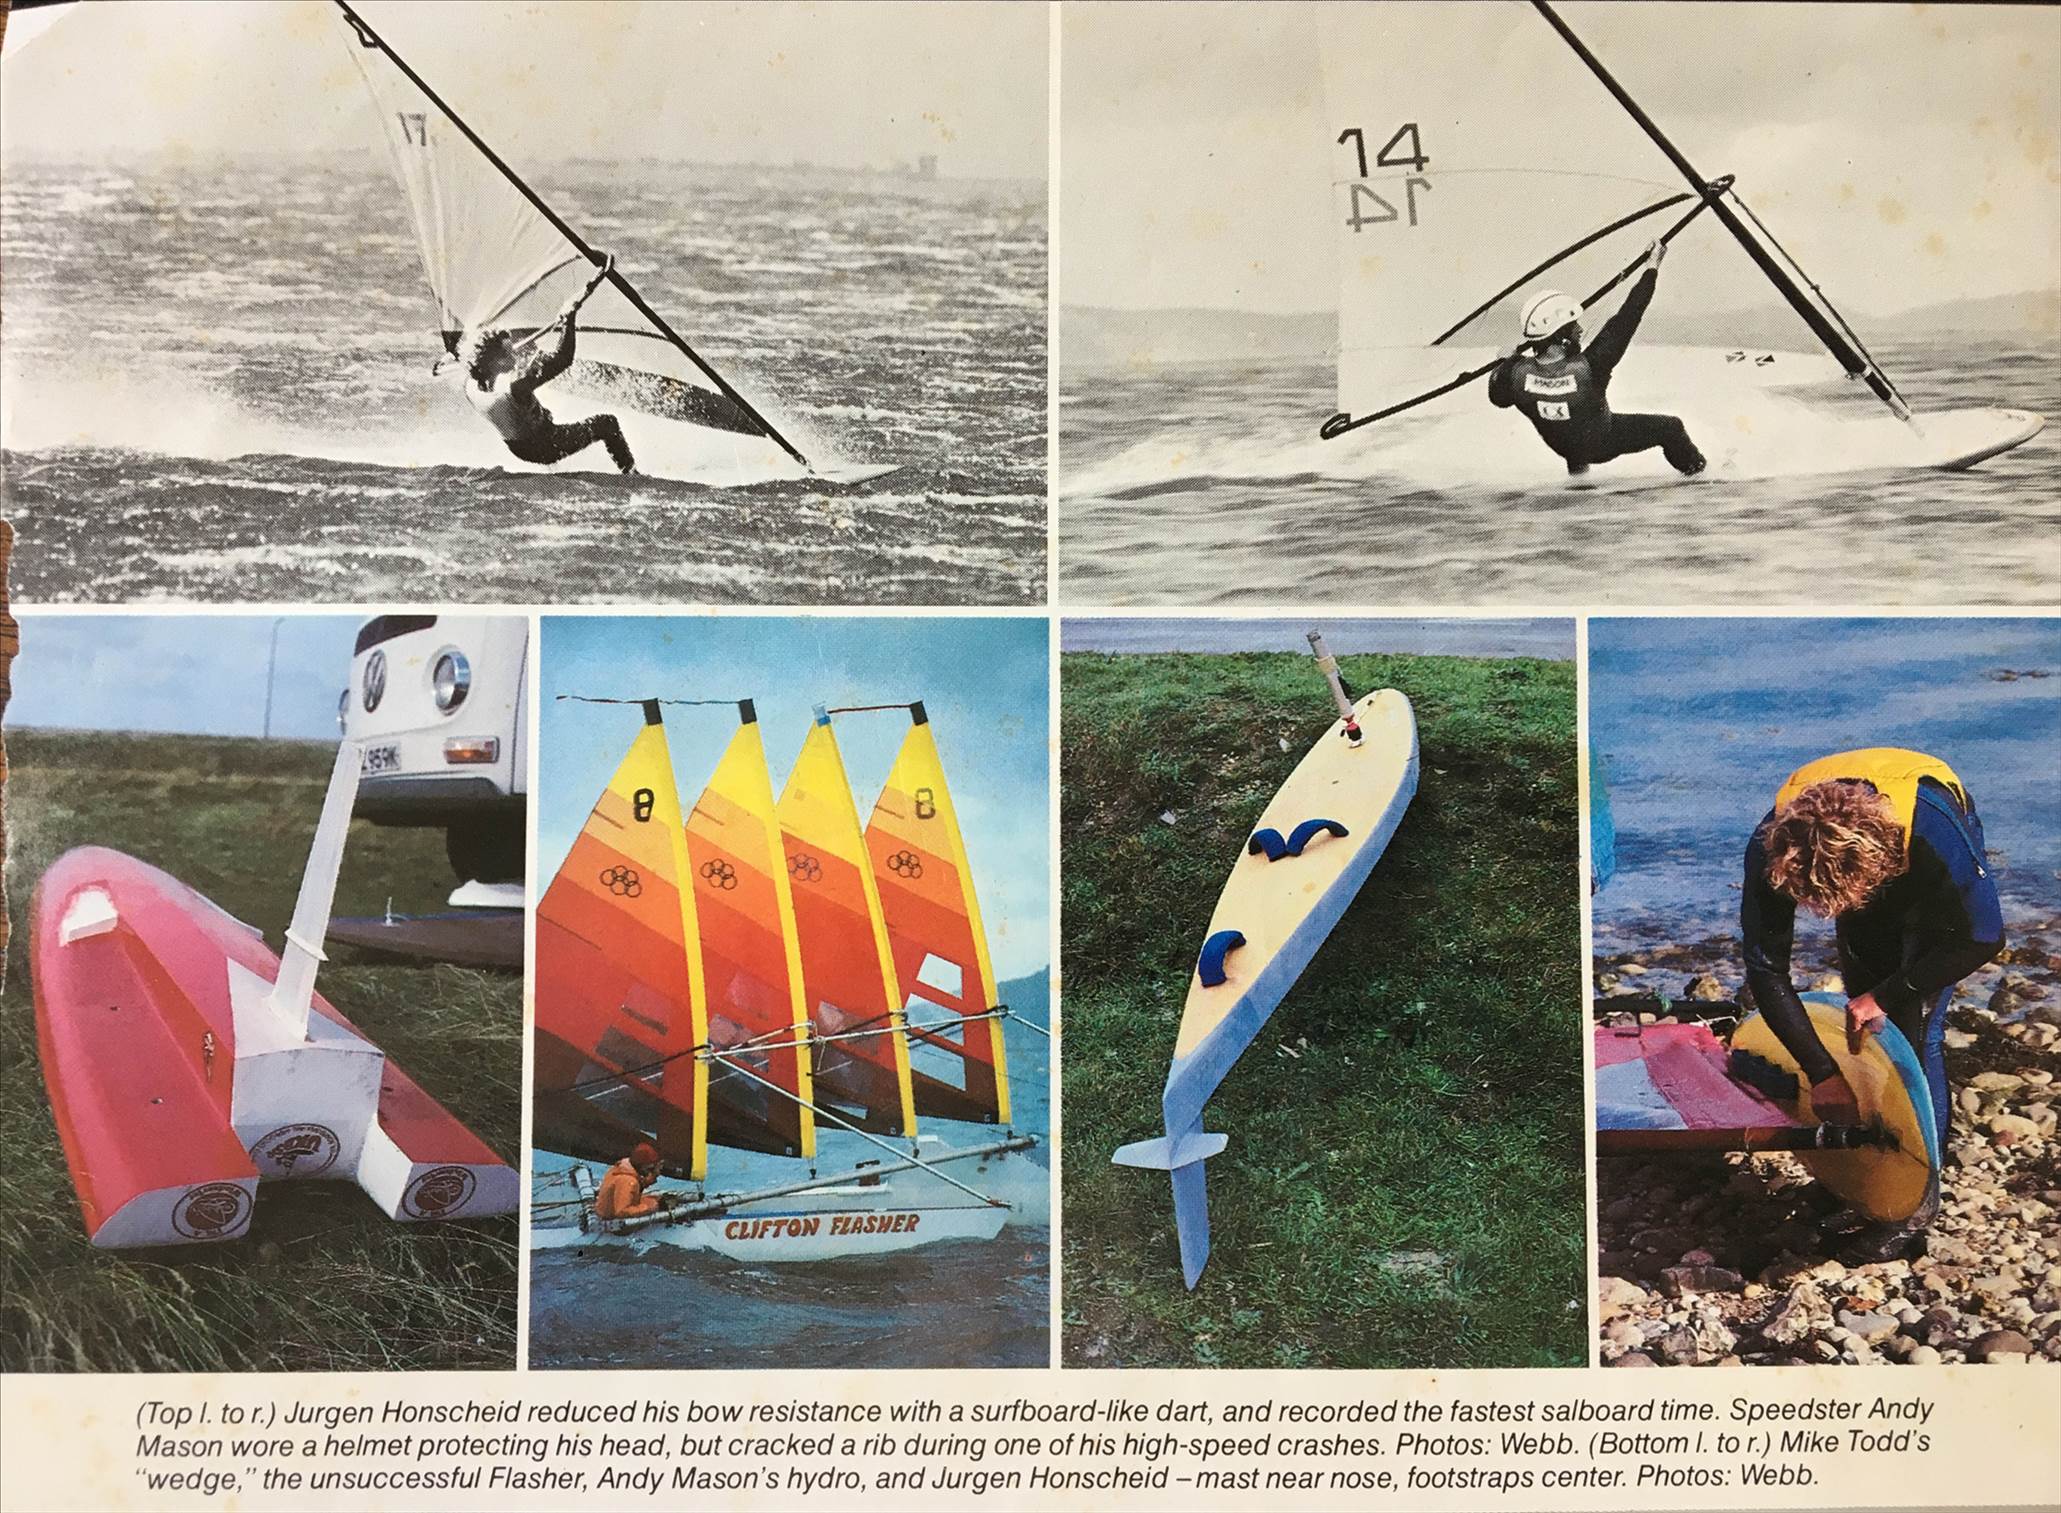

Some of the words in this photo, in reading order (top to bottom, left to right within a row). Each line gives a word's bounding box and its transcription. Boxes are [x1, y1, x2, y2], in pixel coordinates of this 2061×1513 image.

[1337, 122, 1430, 178] 14
[915, 787, 936, 820] 8
[725, 1217, 820, 1241] CLIFTON
[829, 1213, 921, 1236] FLASHER
[136, 1400, 193, 1431] (Top
[199, 1401, 212, 1424] l.
[221, 1402, 245, 1425] to
[250, 1401, 276, 1430] r.)
[283, 1400, 374, 1430] Jurgen
[381, 1399, 523, 1424] Honscheid
[527, 1399, 638, 1424] reduced
[642, 1399, 680, 1424] his
[686, 1399, 745, 1423] bow
[748, 1399, 882, 1423] resistance
[889, 1399, 942, 1423] with
[948, 1404, 964, 1423] a
[970, 1398, 1149, 1423] surfboard-like
[1155, 1398, 1213, 1426] dart,
[1222, 1399, 1273, 1423] and
[1278, 1399, 1399, 1424] recorded
[1403, 1399, 1444, 1423] the
[1450, 1399, 1536, 1423] fastest
[1540, 1398, 1656, 1423] salboard
[1660, 1398, 1720, 1421] time.
[1729, 1397, 1863, 1427] Speedster
[1867, 1396, 1935, 1426] Andy
[135, 1434, 223, 1458] Mason
[231, 1439, 295, 1458] wore
[301, 1439, 318, 1458] a
[323, 1433, 413, 1457] helmet
[416, 1432, 549, 1463] protecting
[555, 1432, 593, 1457] his
[599, 1432, 671, 1461] head,
[680, 1433, 724, 1457] but
[727, 1432, 836, 1457] cracked
[840, 1438, 856, 1457] a
[862, 1432, 897, 1457] rib
[903, 1432, 987, 1462] during
[993, 1437, 1042, 1456] one
[1048, 1432, 1076, 1456] of
[1078, 1432, 1117, 1457] his
[1122, 1432, 1272, 1463] high-speed
[1277, 1433, 1386, 1457] crashes.
[1395, 1432, 1492, 1456] Photos:
[1501, 1431, 1579, 1456] Webb.
[1588, 1431, 1689, 1461] (Bottom
[1695, 1430, 1708, 1454] l.
[1717, 1432, 1741, 1454] to
[1746, 1430, 1772, 1460] r.)
[1779, 1430, 1840, 1453] Mike
[262, 1466, 303, 1490] the
[309, 1465, 482, 1490] unsuccessful
[488, 1465, 588, 1494] Flasher,
[595, 1466, 665, 1496] Andy
[786, 1465, 867, 1496] hydro,
[875, 1465, 927, 1490] and
[931, 1465, 1022, 1496] Jurgen
[1029, 1465, 1170, 1490] Honscheid
[1265, 1471, 1326, 1490] near
[1329, 1471, 1399, 1493] nose,
[1407, 1465, 1535, 1495] footstraps
[1541, 1466, 1627, 1488] center.
[1636, 1463, 1732, 1487] Photos:
[1741, 1463, 1819, 1486] Webb.
